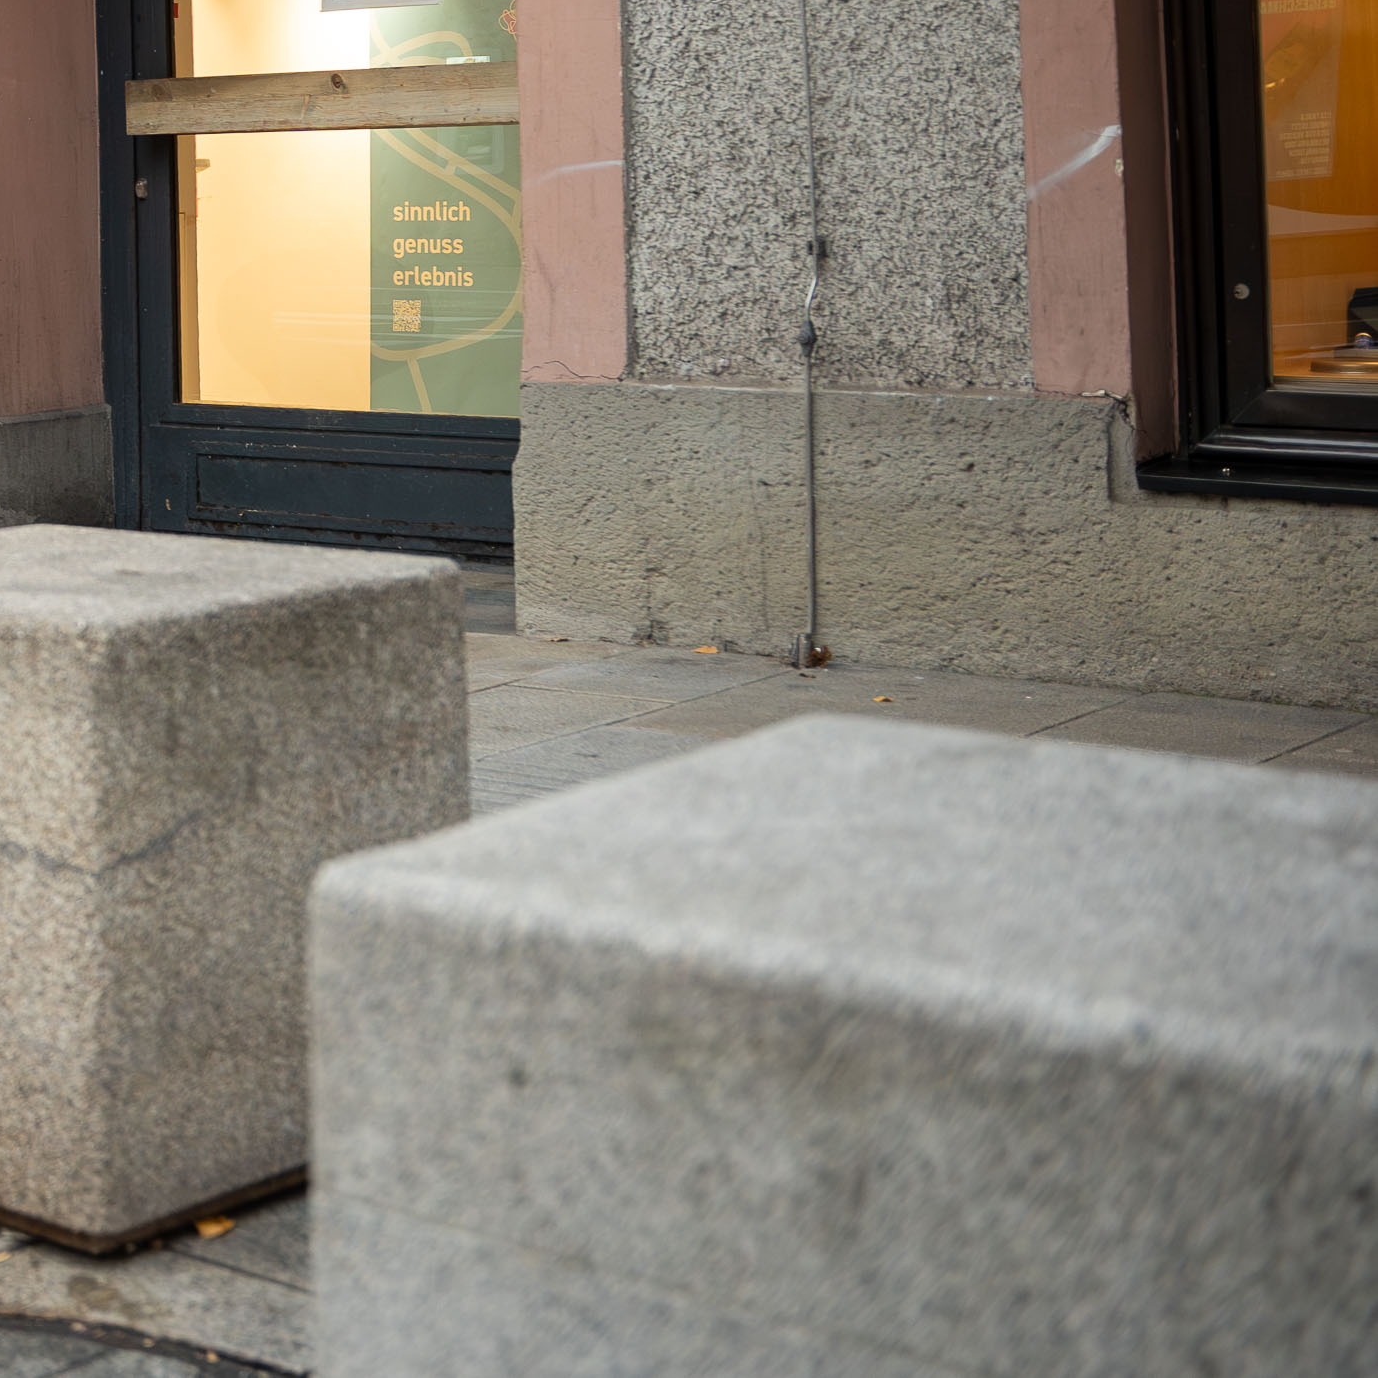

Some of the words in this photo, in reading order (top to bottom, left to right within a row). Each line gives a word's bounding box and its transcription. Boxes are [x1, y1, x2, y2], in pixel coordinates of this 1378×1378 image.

[393, 201, 471, 222] sinnlich
[393, 238, 464, 259] genuss
[393, 265, 474, 287] erlebnis
